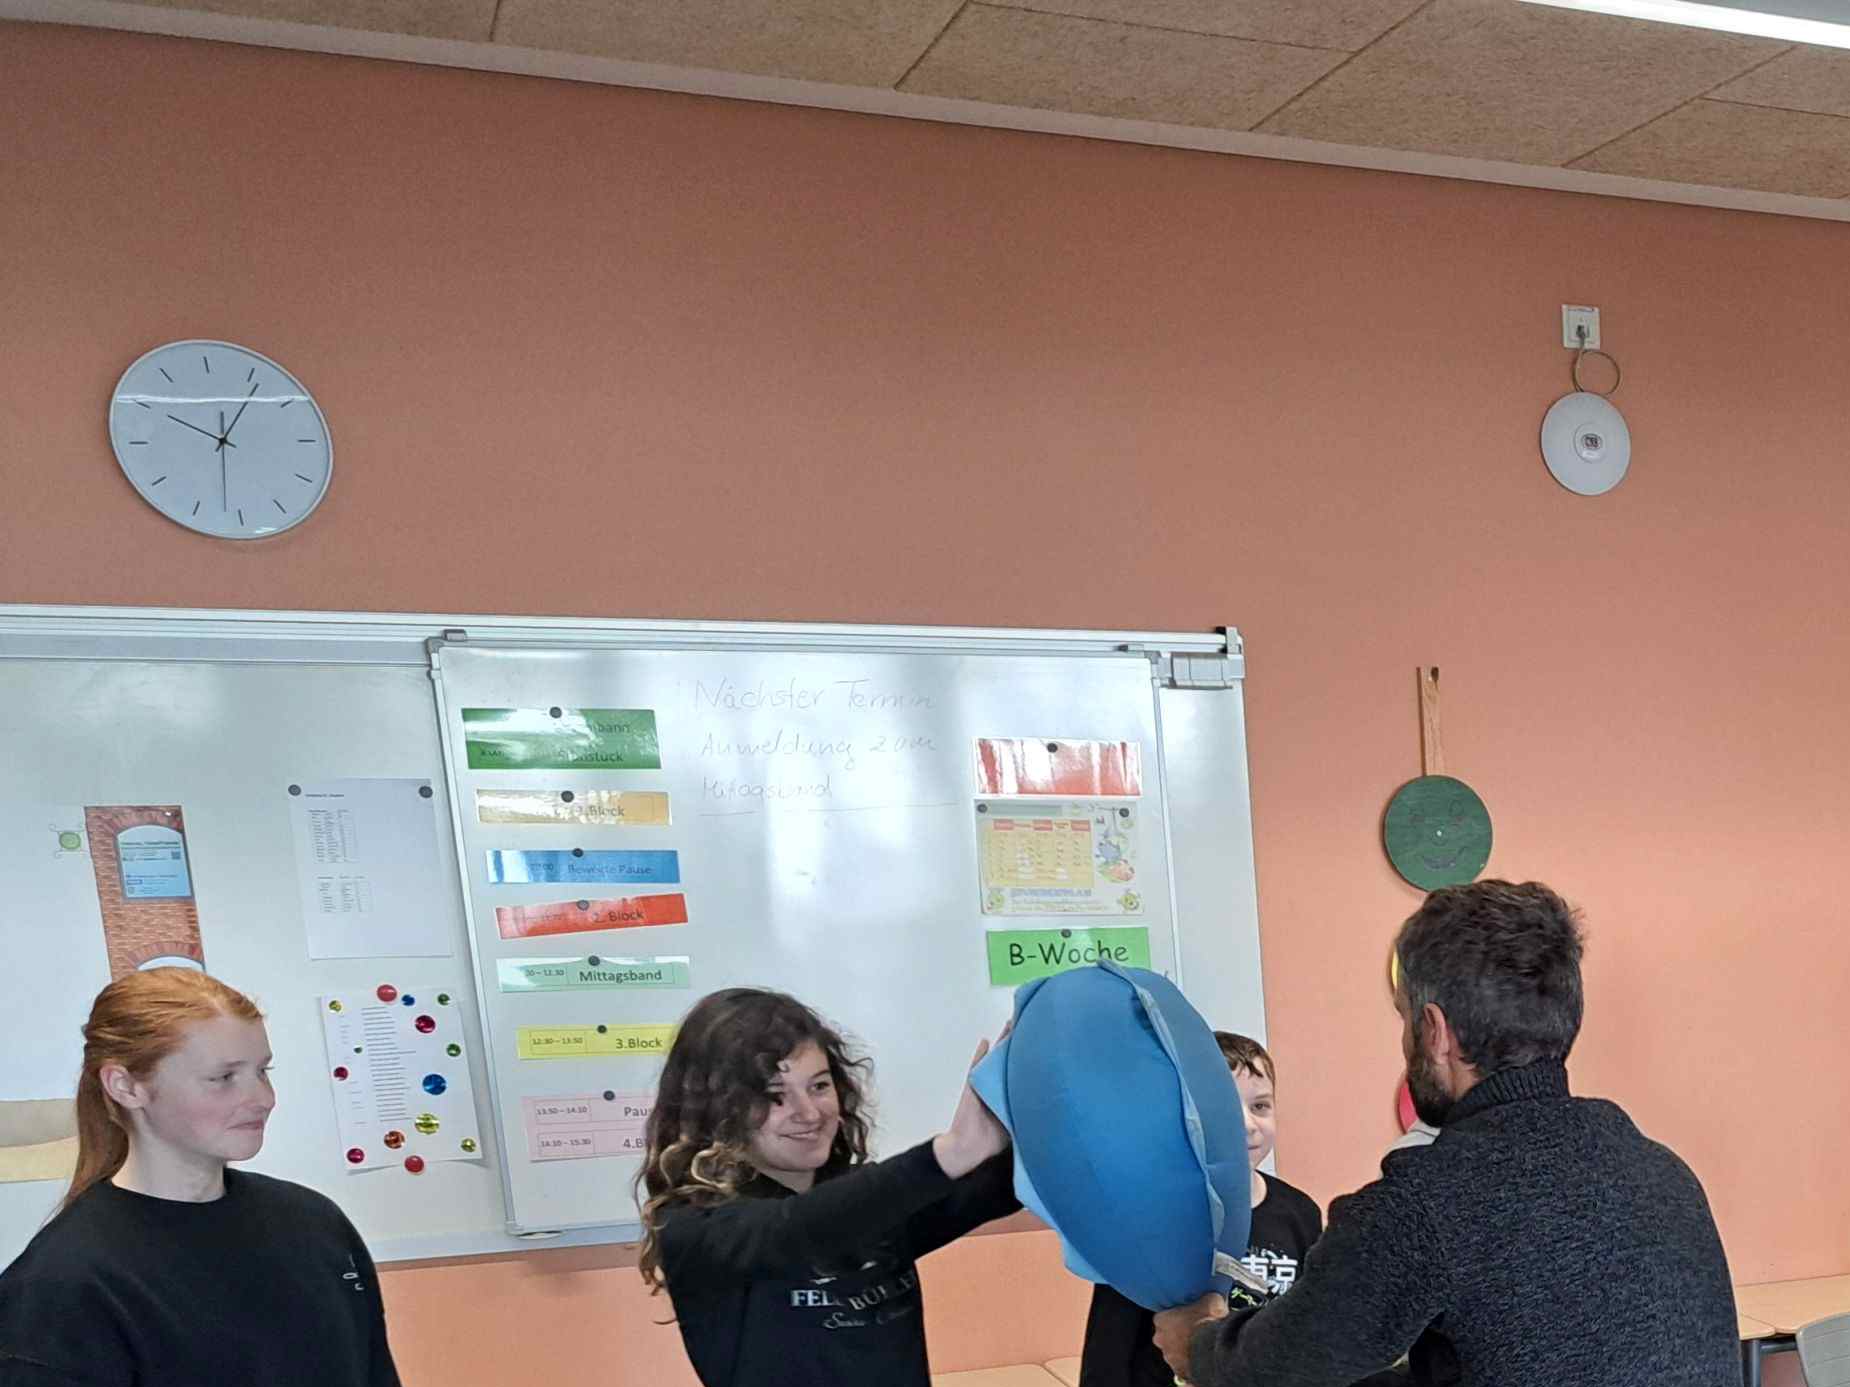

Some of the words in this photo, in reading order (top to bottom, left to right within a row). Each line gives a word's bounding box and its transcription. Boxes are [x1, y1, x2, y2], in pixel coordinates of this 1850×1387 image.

[694, 677, 825, 712] Nächster
[834, 678, 937, 712] Termin
[701, 729, 857, 770] Anmeldung
[618, 864, 654, 874] Pause
[607, 908, 645, 922] Block
[1009, 940, 1129, 966] B-Woche
[579, 969, 662, 984] Mittagsband
[615, 1037, 664, 1050] 3.Block
[623, 1107, 650, 1117] Pau
